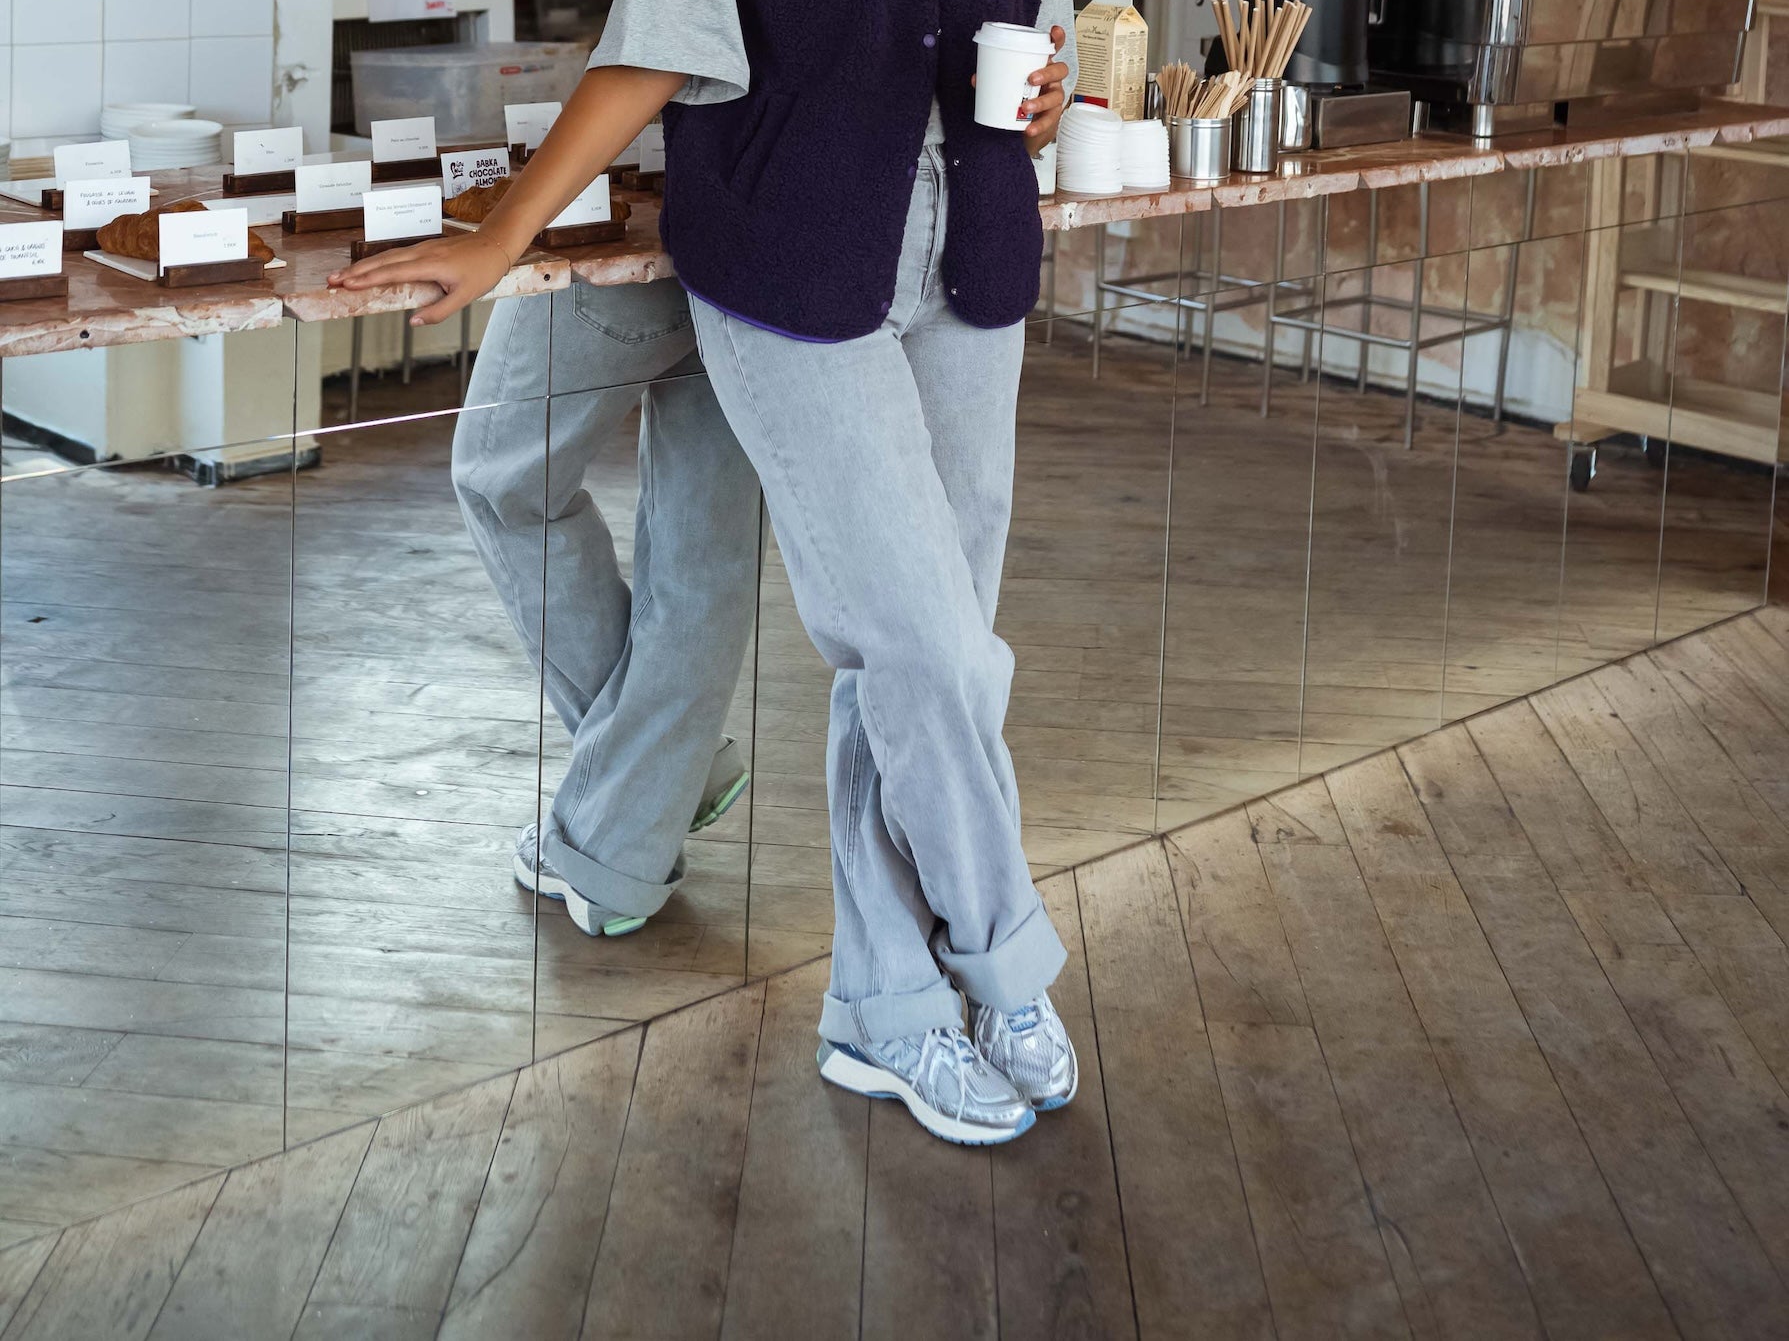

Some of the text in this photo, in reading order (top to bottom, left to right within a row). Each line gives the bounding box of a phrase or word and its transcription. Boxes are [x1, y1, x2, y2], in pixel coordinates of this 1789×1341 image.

[476, 158, 499, 169] BABKA
[469, 166, 507, 179] CHOCOLATE
[475, 176, 503, 187] ALMON
